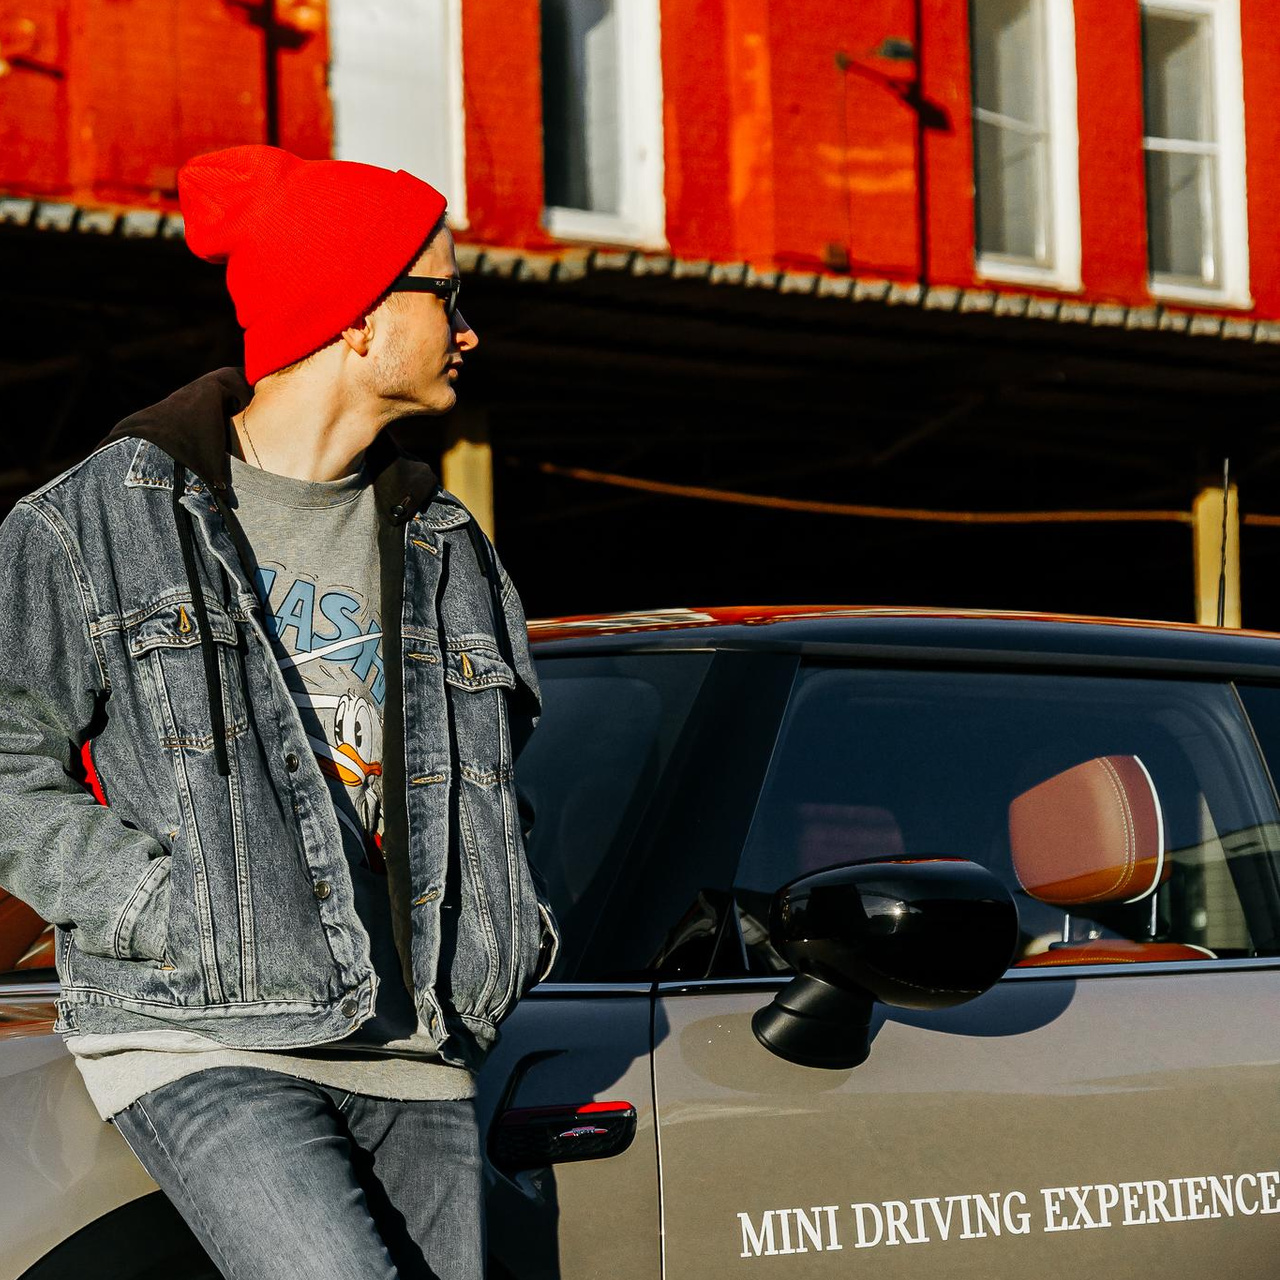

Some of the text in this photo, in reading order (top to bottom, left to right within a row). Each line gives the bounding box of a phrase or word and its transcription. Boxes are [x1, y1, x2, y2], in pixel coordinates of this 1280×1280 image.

[737, 1171, 1280, 1258] MINI DRIVING EXPERIENCE
